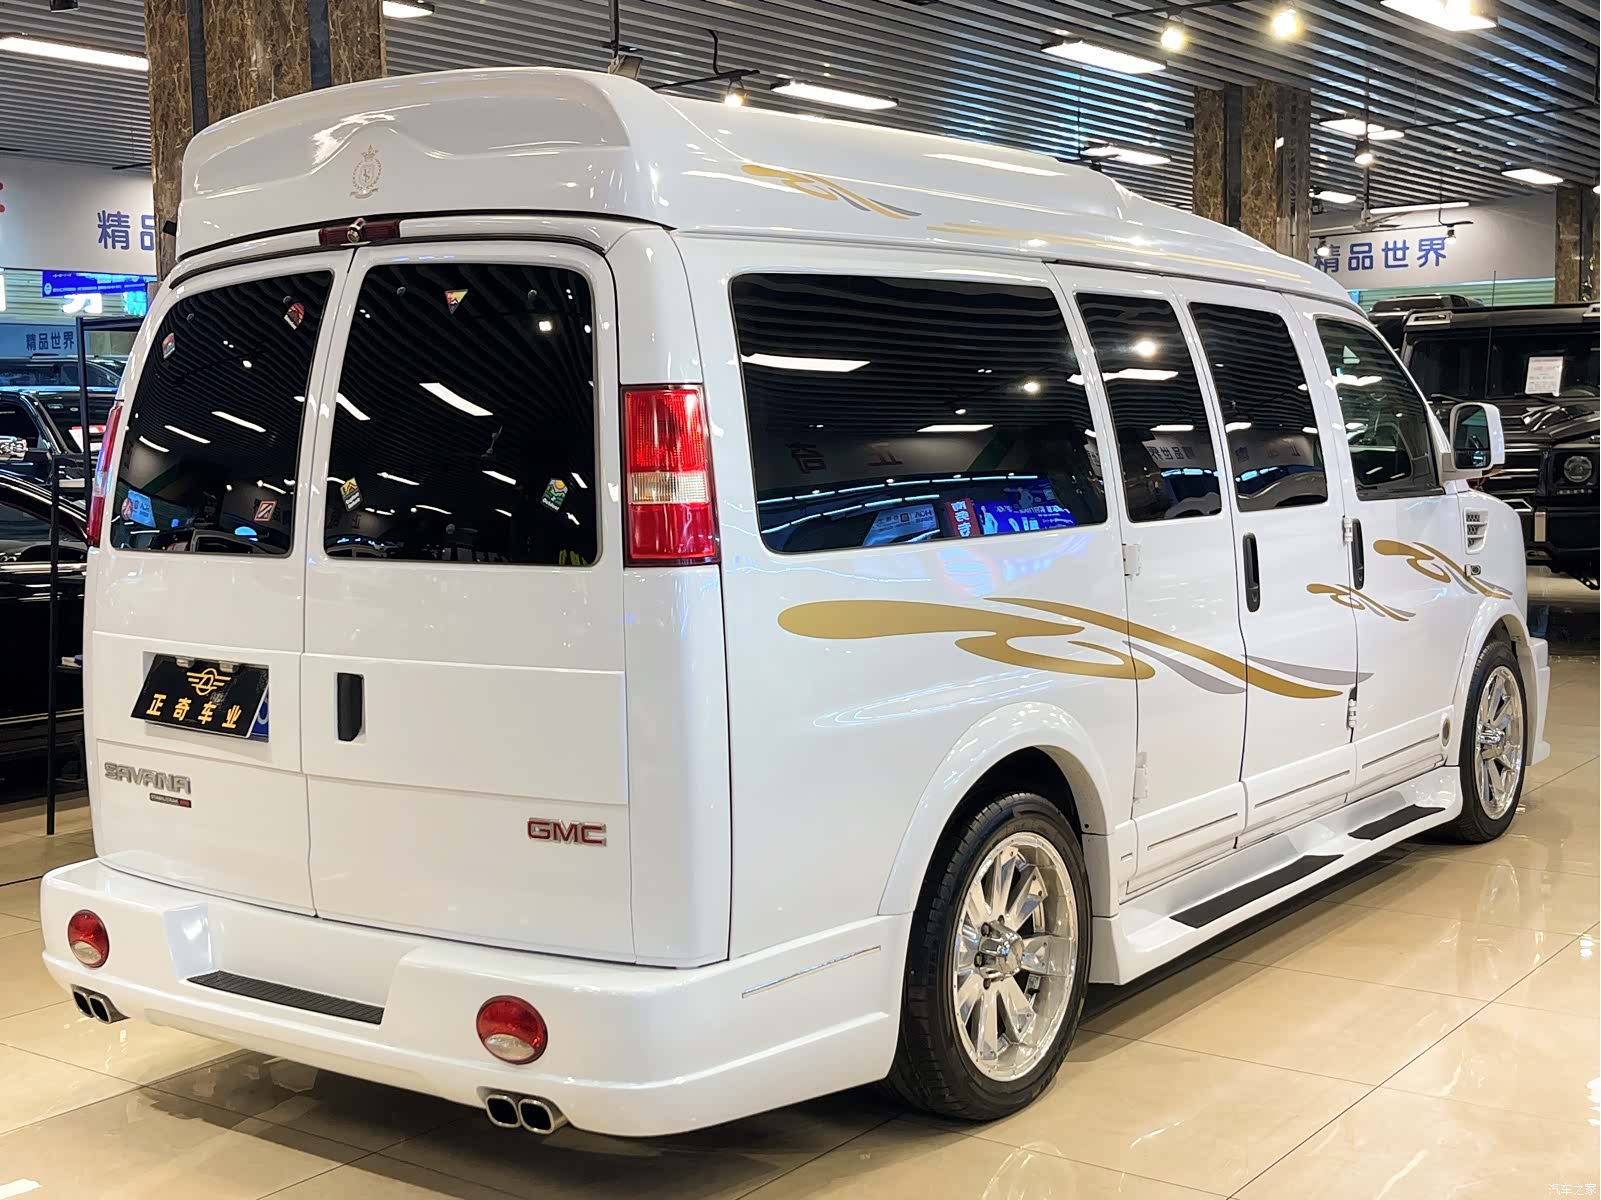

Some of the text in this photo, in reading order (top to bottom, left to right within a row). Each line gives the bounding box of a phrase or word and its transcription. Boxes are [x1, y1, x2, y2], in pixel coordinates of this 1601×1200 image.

[1313, 238, 1447, 273] 精品世界
[25, 331, 75, 351] 精品世界
[146, 693, 243, 730] 正奇车业
[104, 761, 192, 795] SAVANA
[527, 817, 608, 847] GMC
